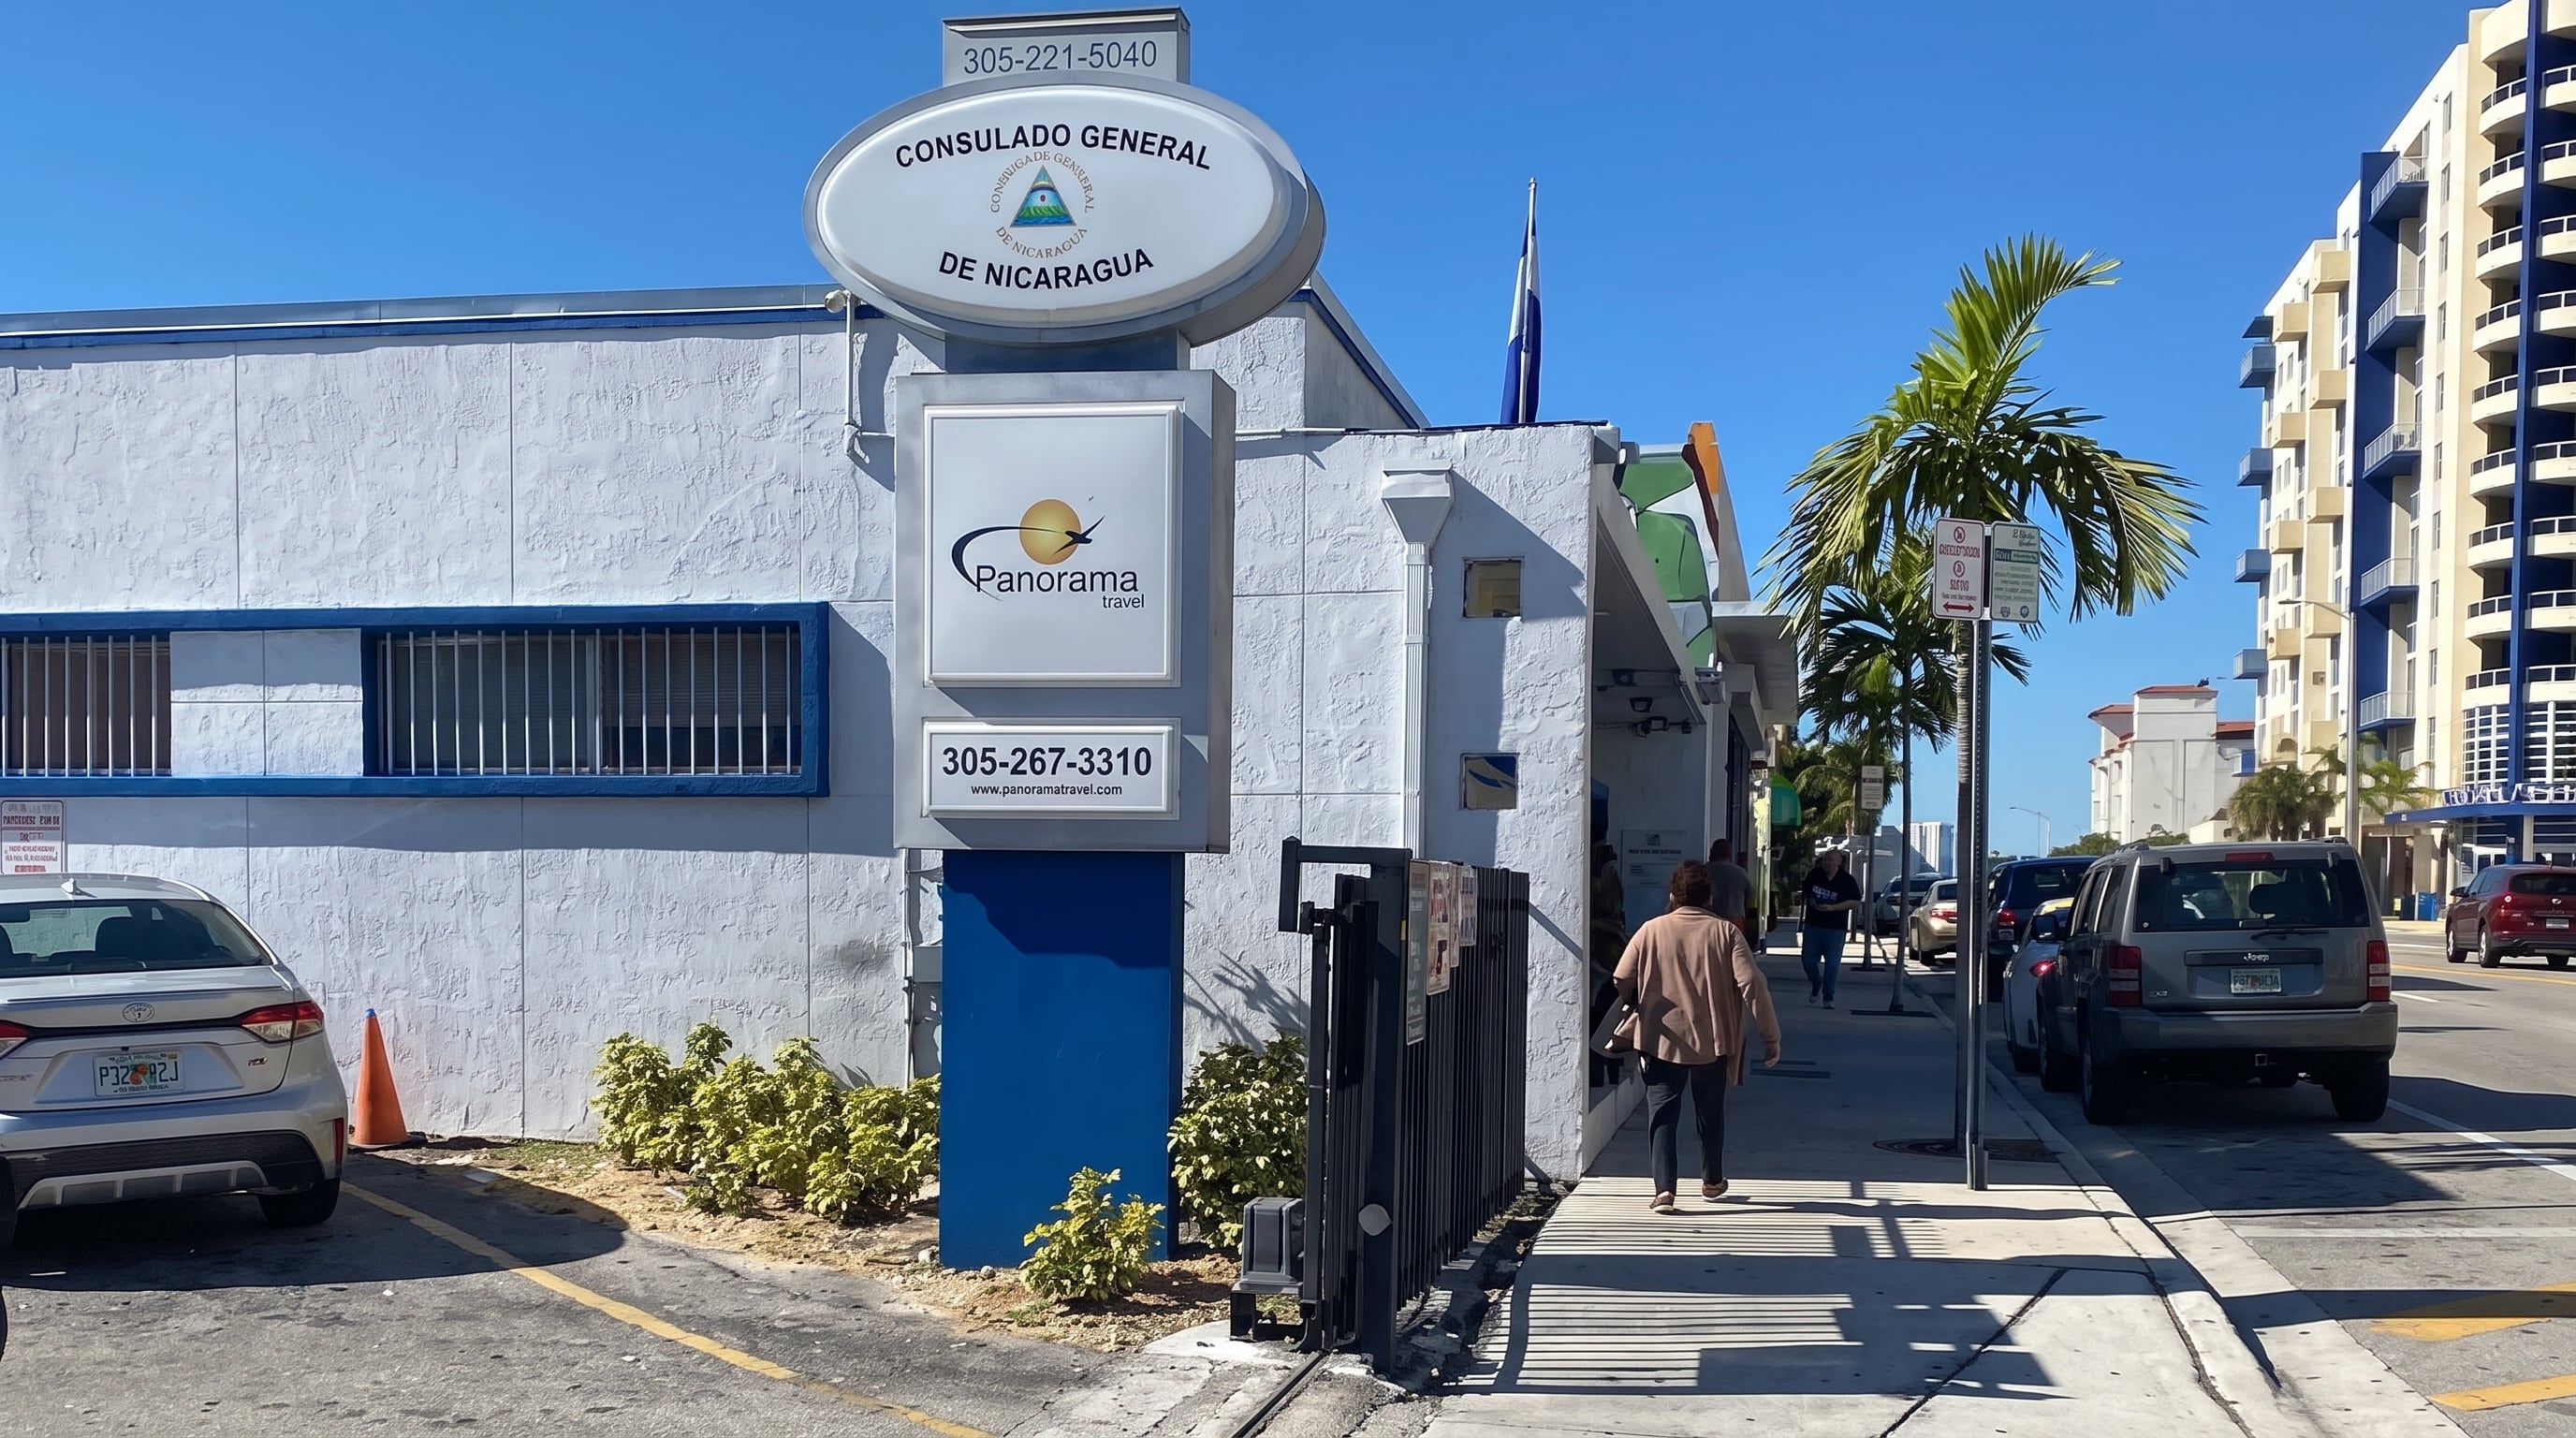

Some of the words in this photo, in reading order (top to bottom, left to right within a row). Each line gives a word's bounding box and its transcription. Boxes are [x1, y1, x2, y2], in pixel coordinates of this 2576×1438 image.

[963, 40, 1157, 74] 305-221-5040
[896, 124, 1071, 168] CONSULADO
[1081, 125, 1211, 169] GENERAL
[996, 227, 1013, 245] DE
[1012, 227, 1087, 258] NICARAGUA
[939, 251, 977, 281] DE
[985, 248, 1154, 289] NICARAGUA
[975, 565, 1139, 594] Panorama
[1102, 593, 1145, 609] travel
[943, 746, 1152, 777] 305-267-3310
[971, 784, 1122, 798] www.panoramatravel.com
